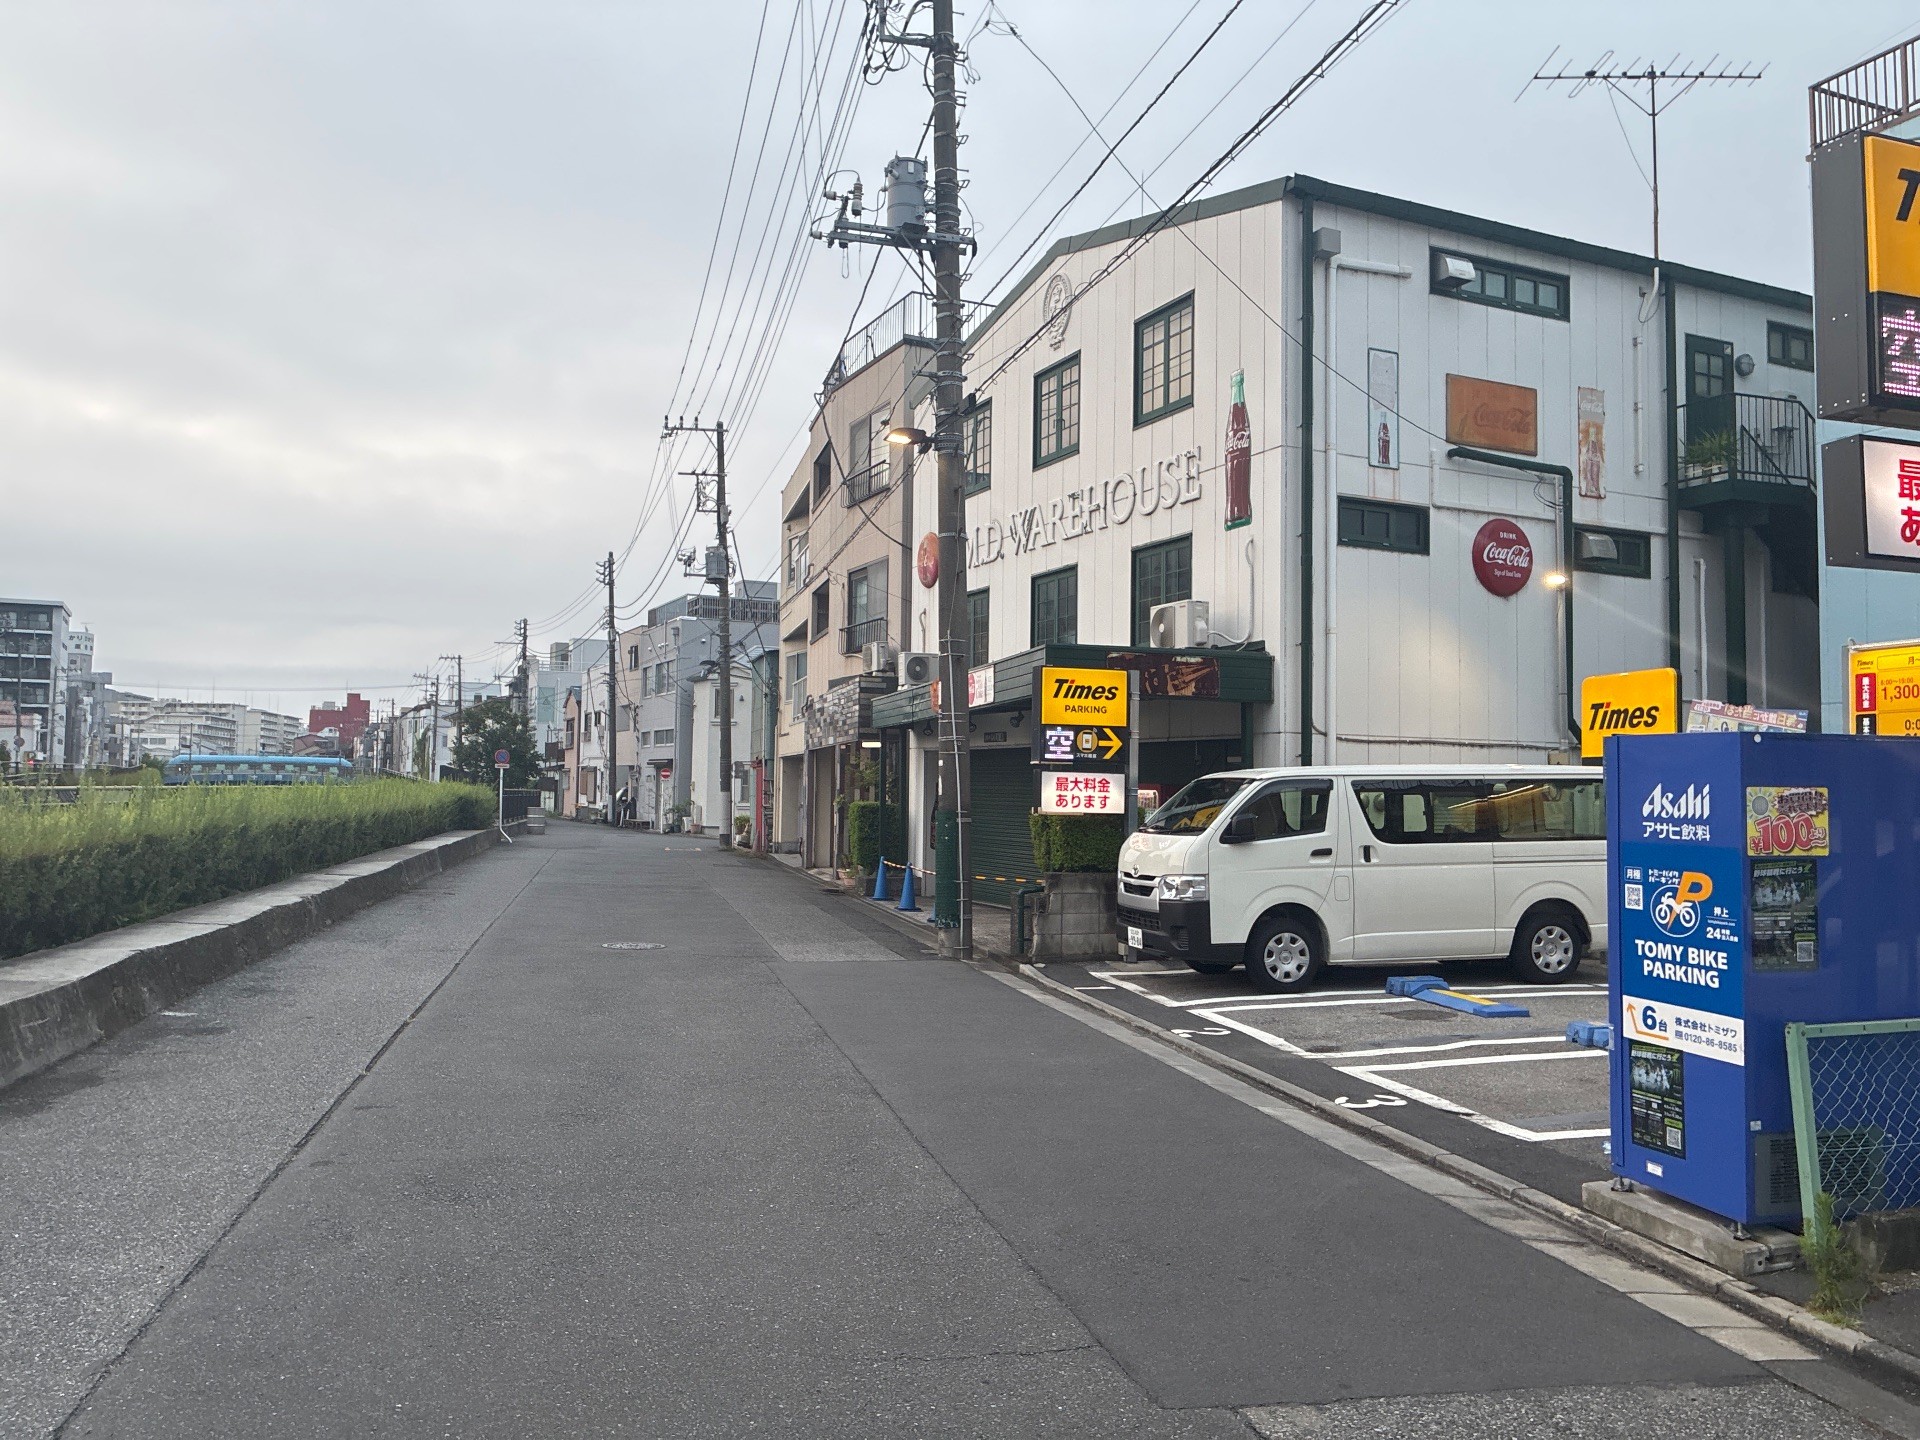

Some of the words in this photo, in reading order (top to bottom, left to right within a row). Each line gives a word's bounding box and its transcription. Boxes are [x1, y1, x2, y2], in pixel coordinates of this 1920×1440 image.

[1009, 446, 1203, 556] WAREHOUSE
[1499, 531, 1517, 540] DRINK
[1053, 678, 1119, 701] Times
[1881, 683, 1920, 702] 1,300
[1064, 704, 1107, 714] PARKING
[1589, 701, 1660, 731] Times
[1044, 726, 1075, 759] 空
[1055, 776, 1111, 793] 最大料金
[1055, 794, 1111, 809] あります
[1642, 782, 1710, 820] Asahi
[1642, 821, 1711, 842] アサヒ飲料
[1626, 868, 1641, 880] 月極
[1713, 906, 1729, 918] 押上
[1634, 939, 1684, 963] TOMY
[1687, 947, 1729, 970] BIKE
[1643, 959, 1720, 988] PARKING
[1674, 1016, 1738, 1039] 株式会社トミザワ
[1683, 1032, 1738, 1052] 0120-86-8585
[1334, 1094, 1408, 1108] 3
